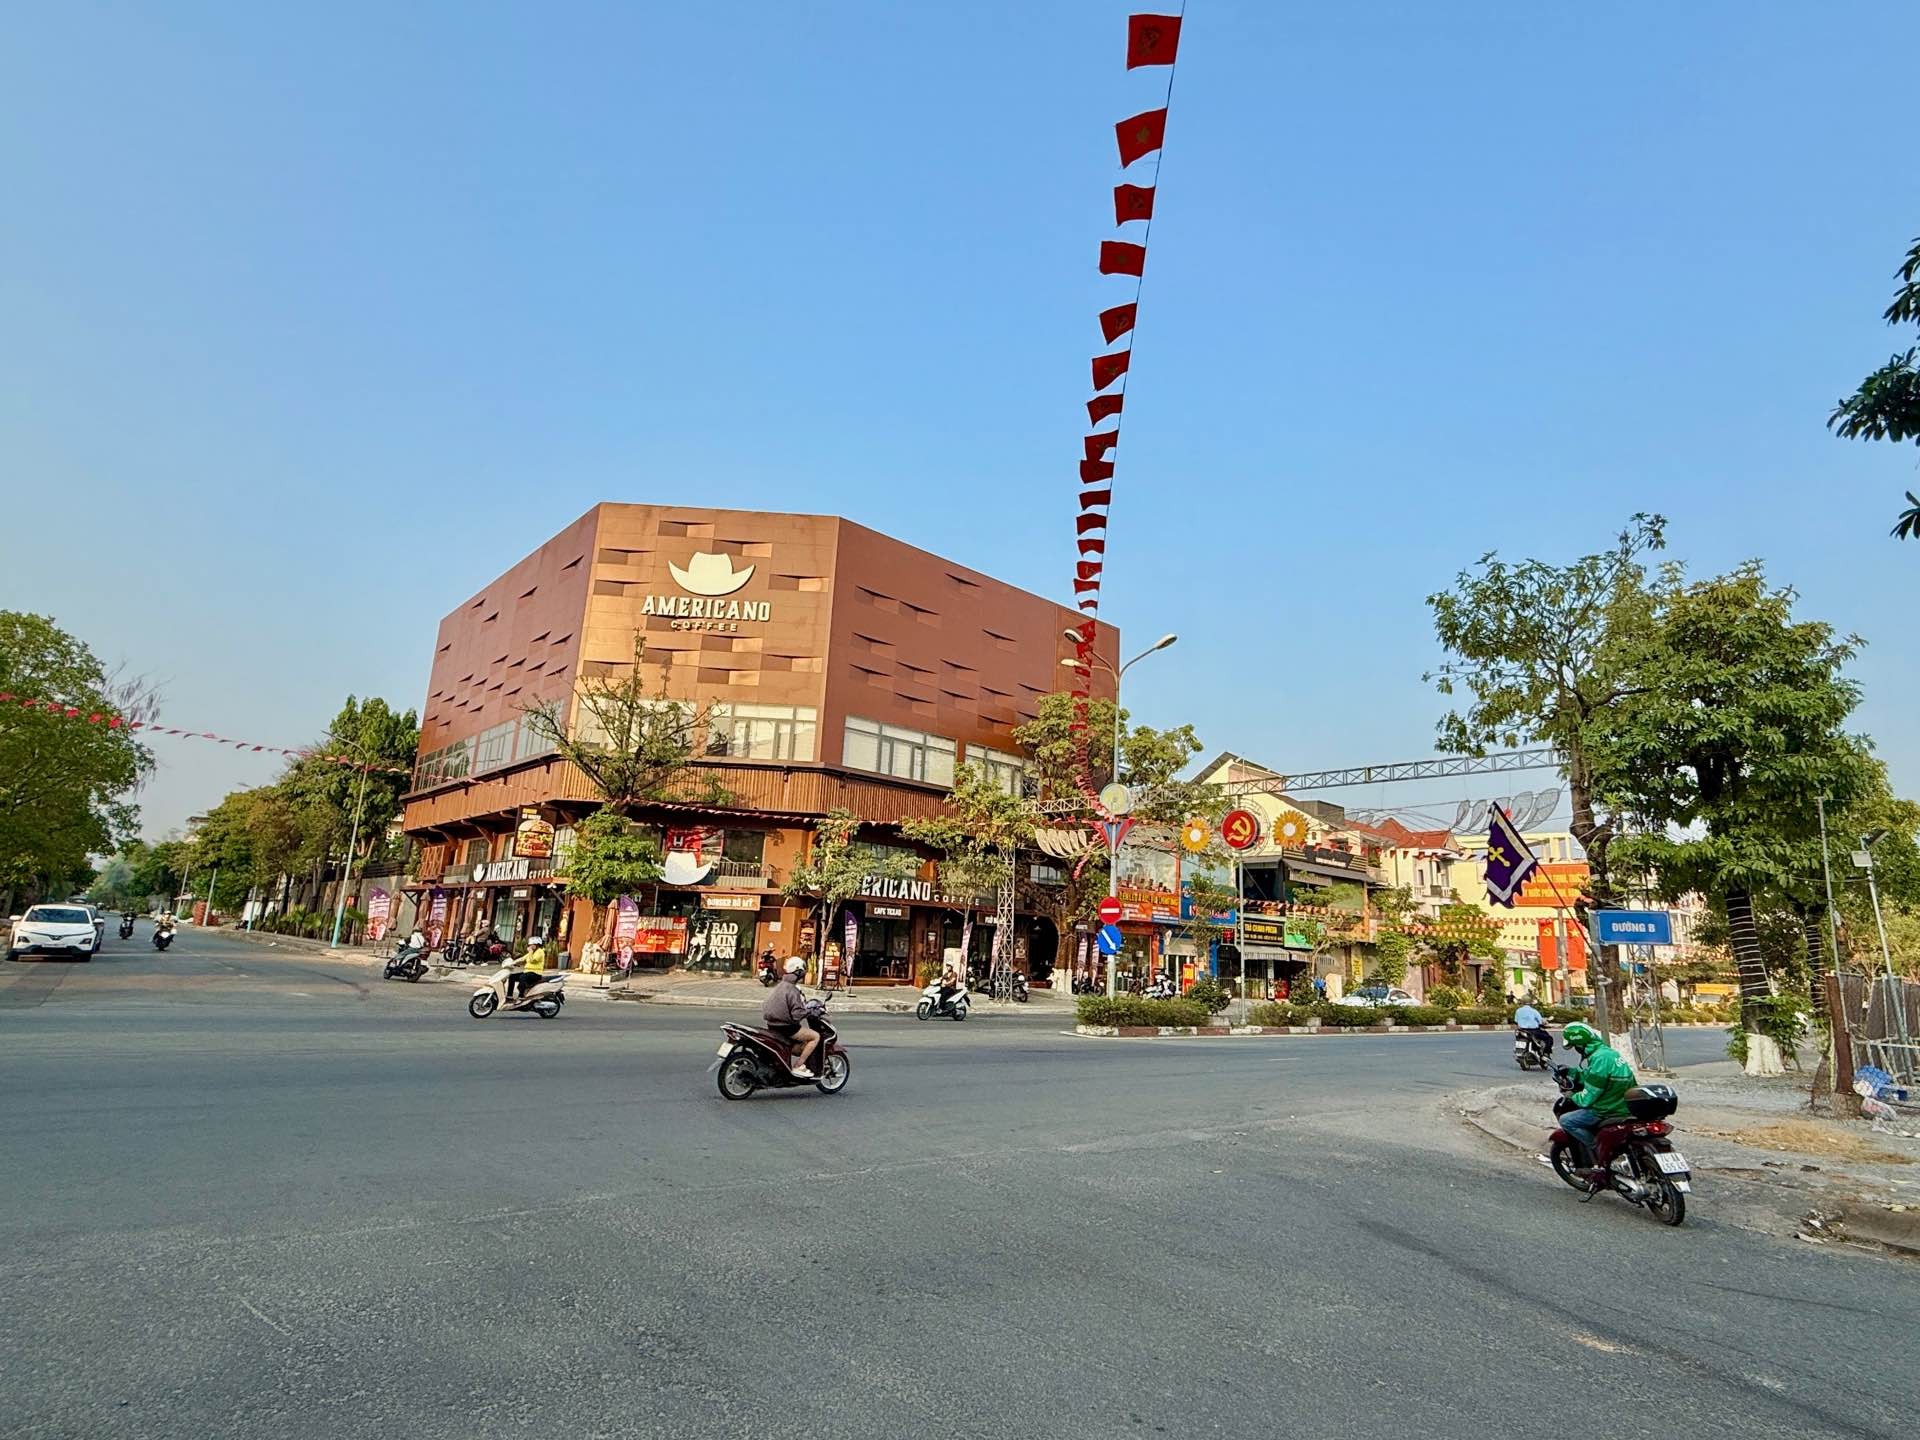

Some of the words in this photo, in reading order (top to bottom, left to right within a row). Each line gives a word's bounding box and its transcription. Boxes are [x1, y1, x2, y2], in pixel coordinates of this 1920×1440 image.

[641, 595, 771, 621] AMERICANO
[670, 620, 738, 632] COFFEE
[485, 860, 529, 881] AMERICANO
[711, 922, 739, 935] BAD
[1612, 920, 1646, 933] ĐƯỜNG
[1648, 923, 1656, 933] B
[710, 934, 738, 947] MIN
[709, 946, 737, 959] TON
